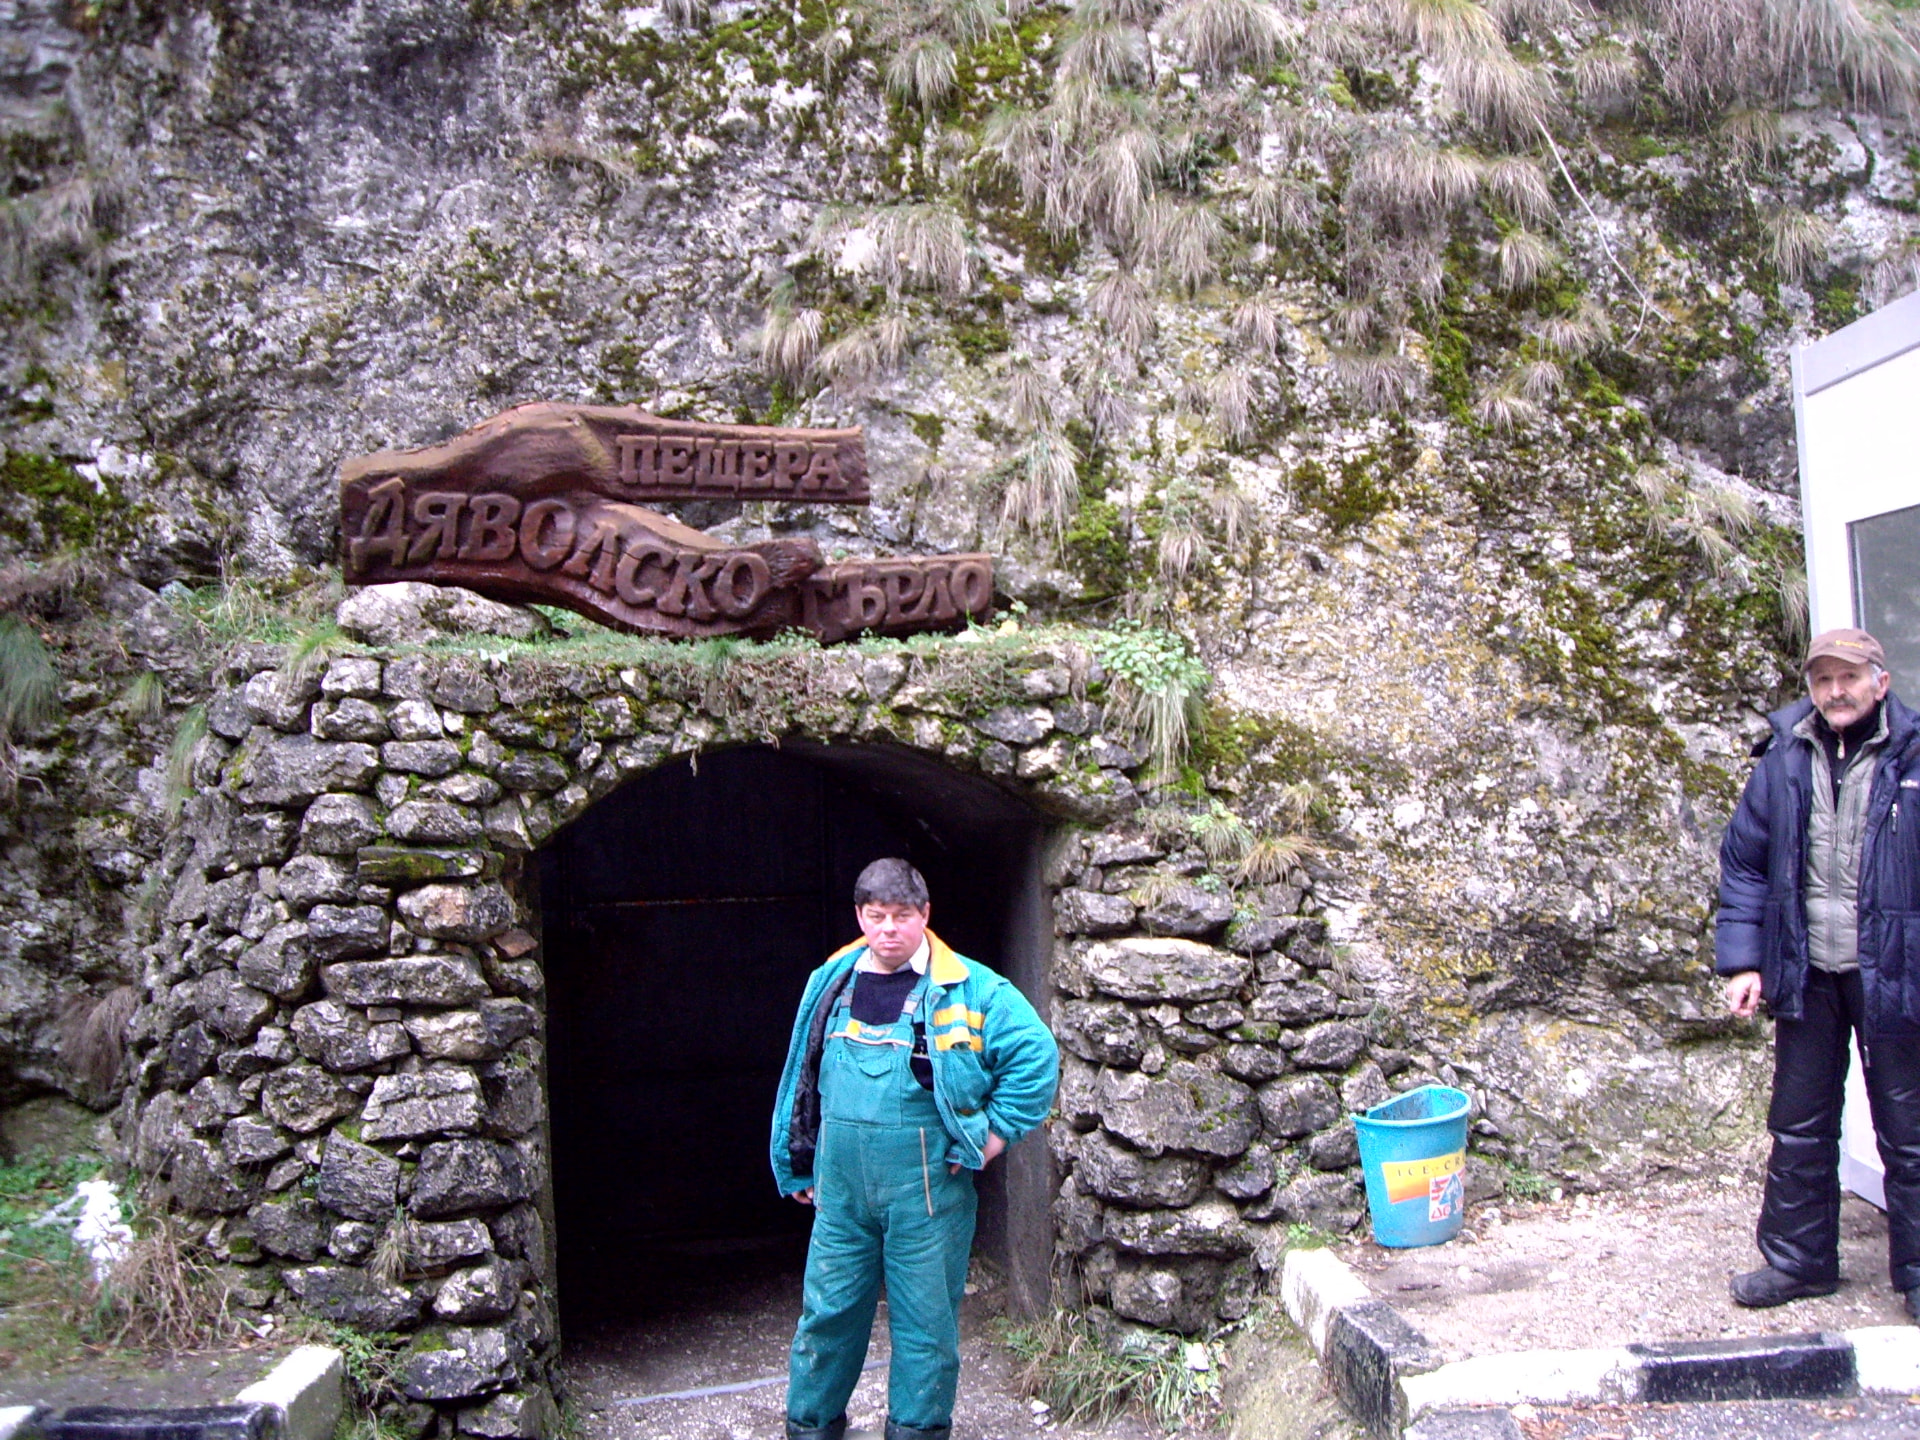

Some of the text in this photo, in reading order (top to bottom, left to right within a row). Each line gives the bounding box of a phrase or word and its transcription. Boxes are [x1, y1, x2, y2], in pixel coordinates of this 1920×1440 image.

[616, 434, 849, 492] ПЕЩЕРА
[350, 476, 991, 637] ДЯВОЛСКО ГЪРЛО
